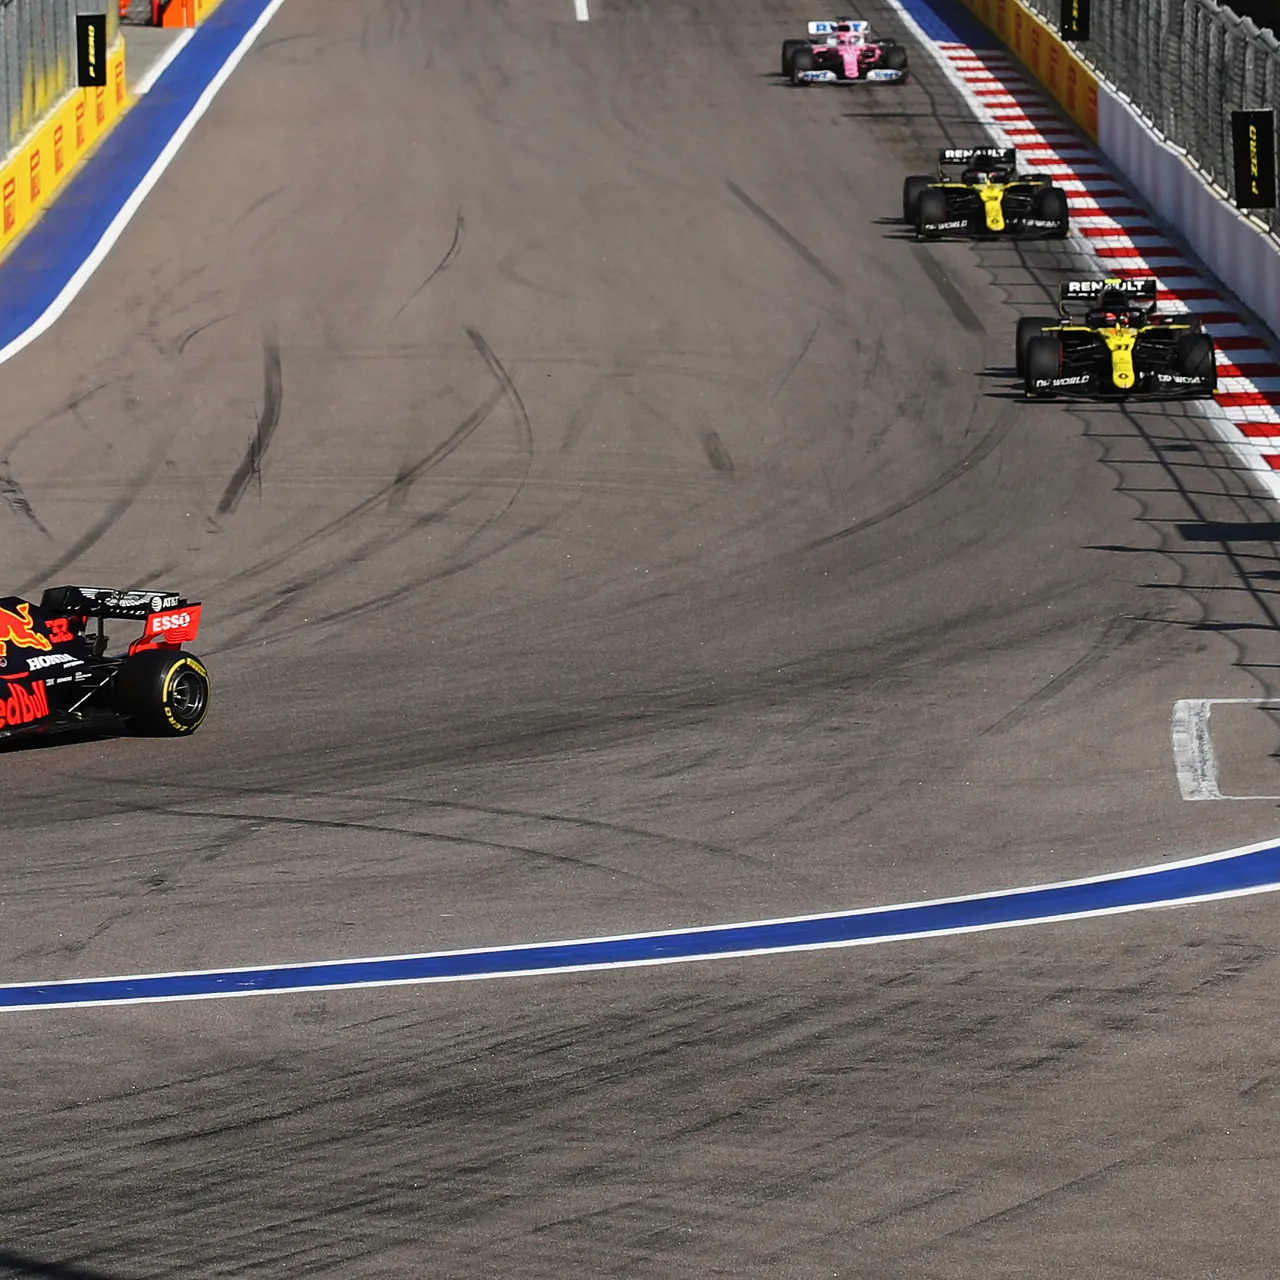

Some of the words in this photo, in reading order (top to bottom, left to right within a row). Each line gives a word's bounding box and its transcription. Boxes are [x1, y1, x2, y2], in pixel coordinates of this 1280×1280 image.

[89, 66, 96, 77] P
[1249, 125, 1258, 177] ZERO
[1250, 180, 1259, 195] P
[152, 612, 191, 633] ESSO
[26, 653, 79, 671] HONDA
